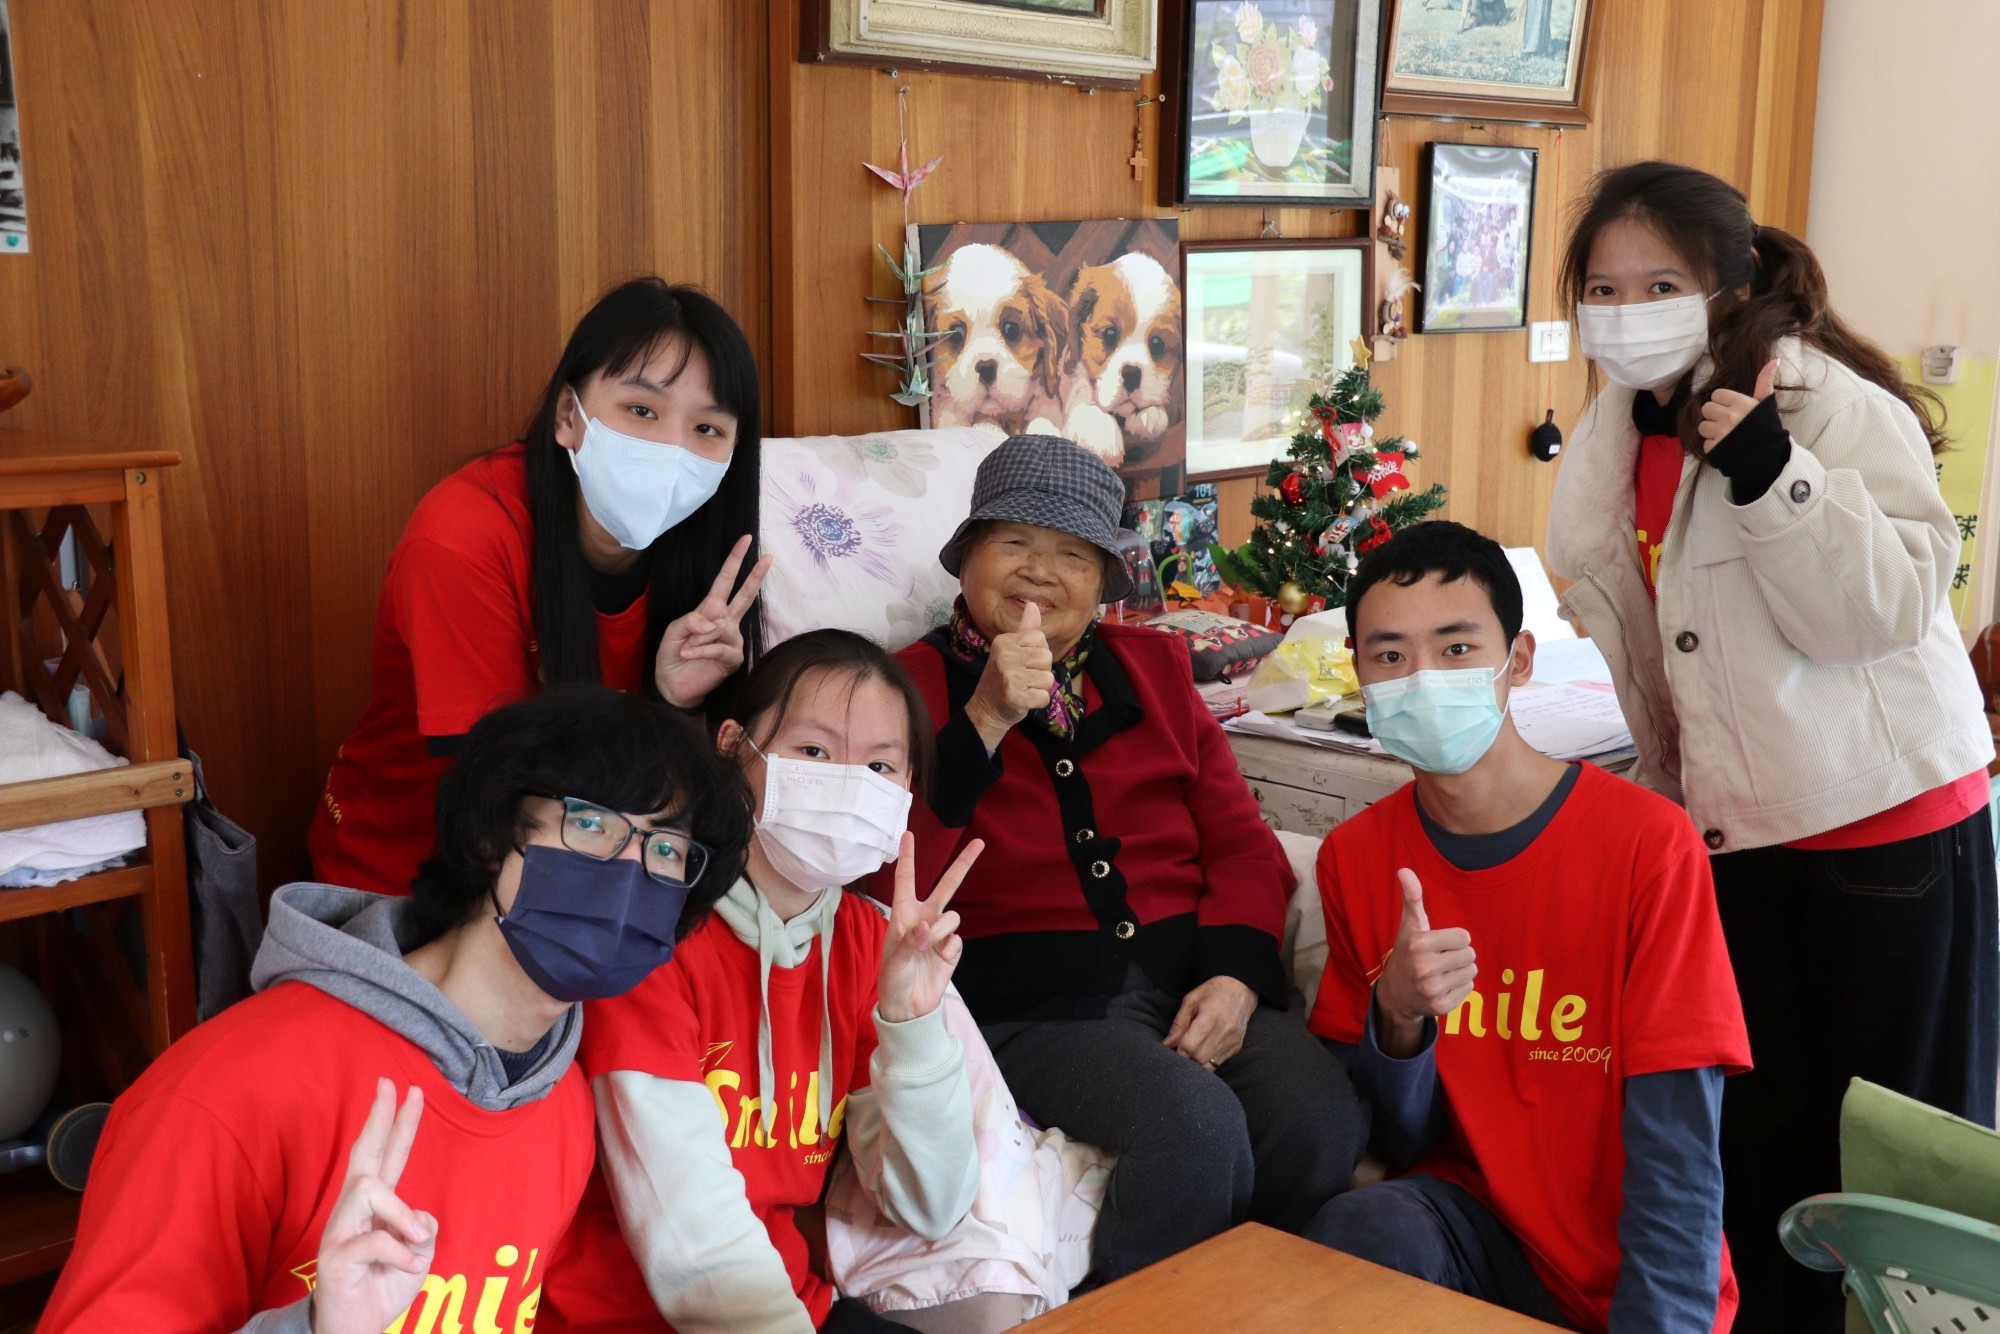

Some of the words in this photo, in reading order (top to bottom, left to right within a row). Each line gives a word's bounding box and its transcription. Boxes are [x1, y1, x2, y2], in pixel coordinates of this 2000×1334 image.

[1194, 483, 1212, 499] 101
[1435, 968, 1588, 1042] mile
[1528, 1046, 1559, 1061] since
[1561, 1046, 1612, 1074] 2009
